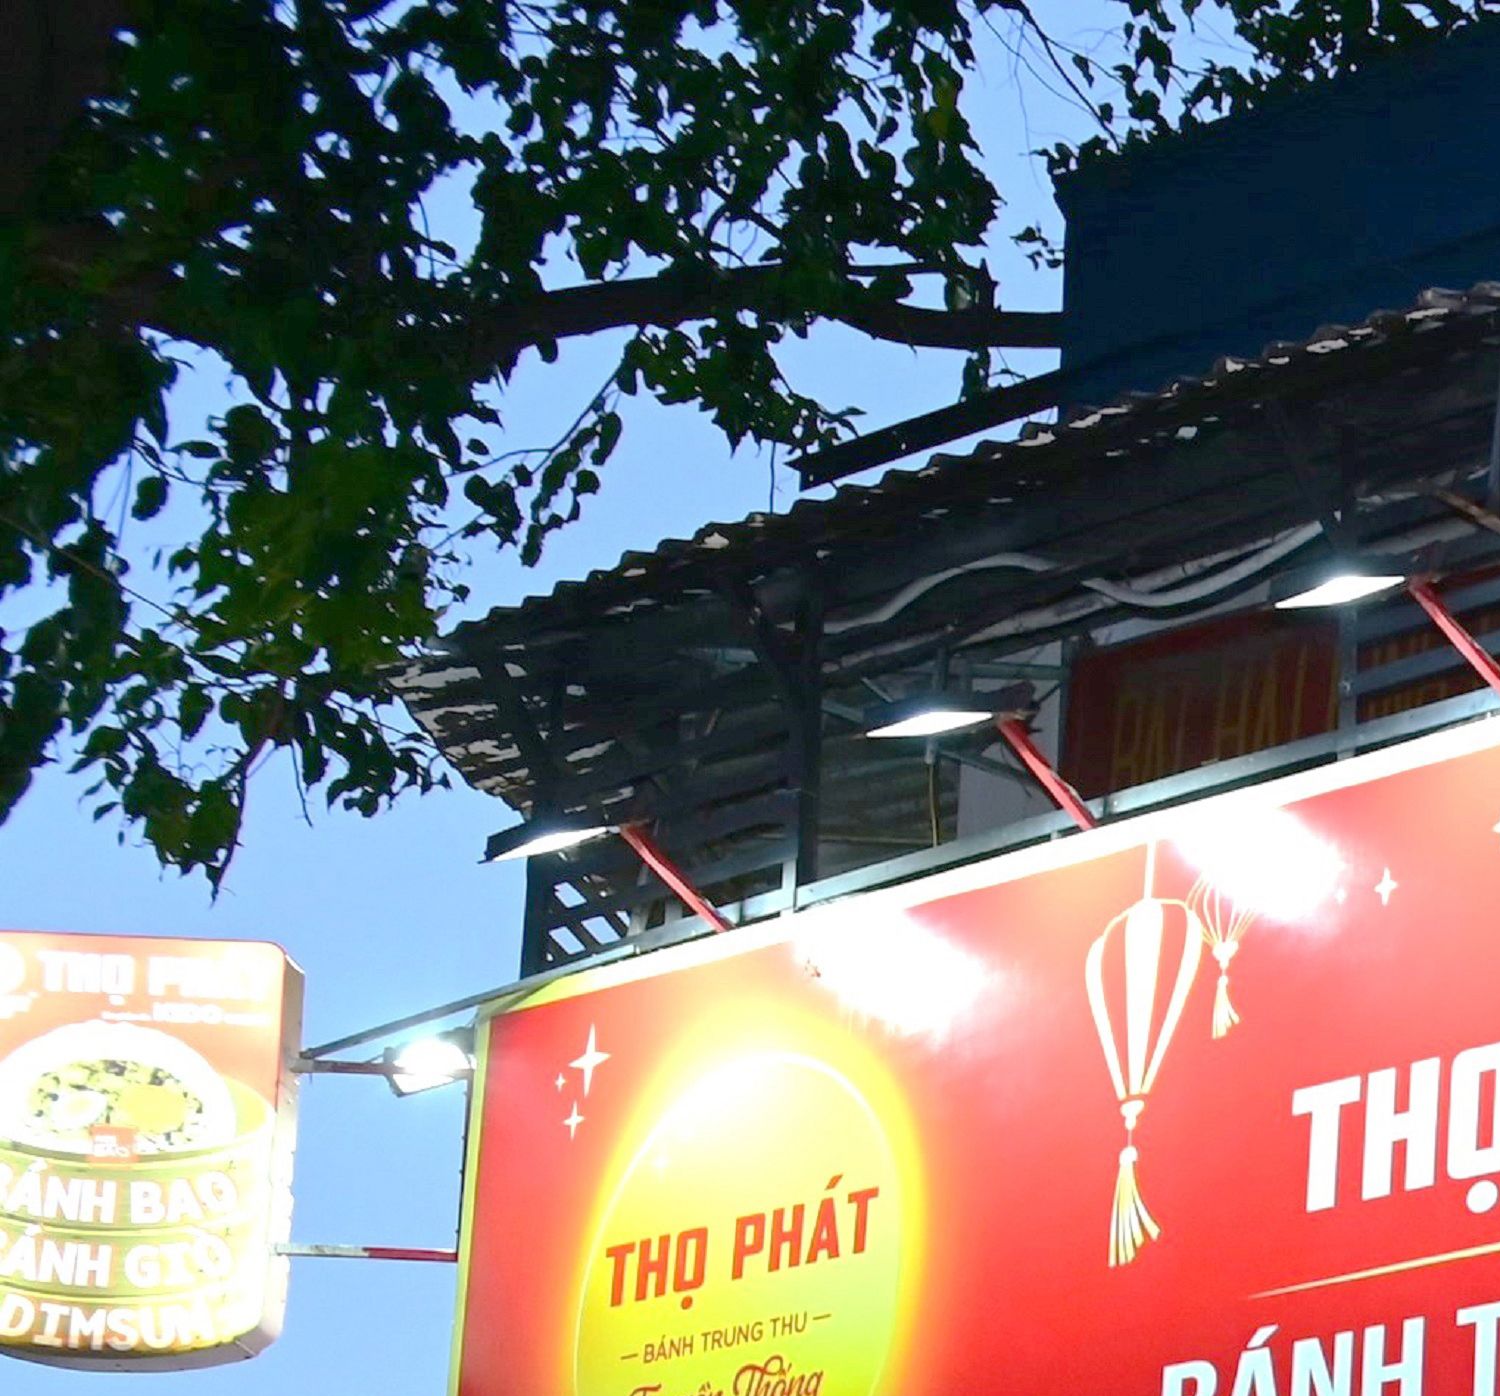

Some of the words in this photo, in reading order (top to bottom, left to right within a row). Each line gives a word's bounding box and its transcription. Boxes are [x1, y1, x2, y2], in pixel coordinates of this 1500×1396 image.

[606, 1227, 708, 1310] THỌ
[731, 1174, 880, 1281] PHÁT
[643, 1334, 694, 1364] BÁNH
[701, 1321, 763, 1353] TRUNG
[771, 1311, 808, 1338] THU
